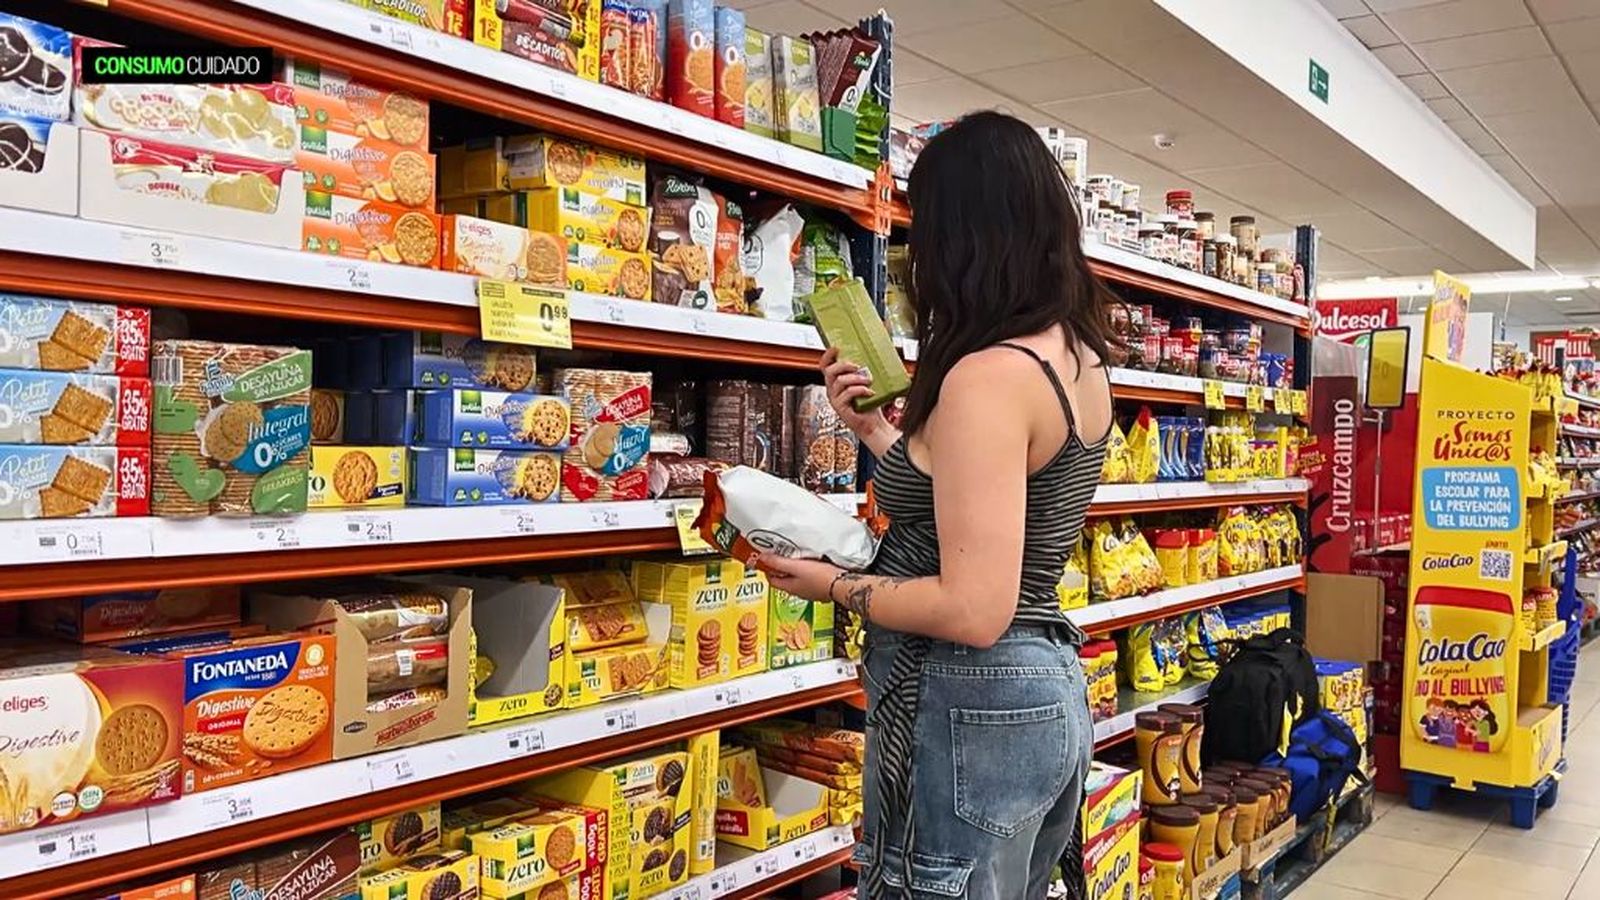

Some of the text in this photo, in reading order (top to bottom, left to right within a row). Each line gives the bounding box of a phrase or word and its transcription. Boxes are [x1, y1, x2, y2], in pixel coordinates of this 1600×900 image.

[335, 210, 391, 228] Digestive
[151, 242, 162, 257] 3
[347, 268, 357, 283] 2
[540, 302, 554, 333] 0
[240, 364, 303, 392] DESAYUNA
[121, 388, 148, 415] 35%
[253, 386, 270, 399] SIN
[120, 414, 148, 432] GRATIS
[1437, 410, 1515, 420] PROYECTO
[248, 409, 309, 443] Integral
[1453, 421, 1513, 446] Somos
[1433, 433, 1512, 462] Únic@s
[121, 457, 147, 484] 35%
[1325, 399, 1354, 532] Cruzcampo
[1444, 471, 1500, 484] PROGRAMA
[120, 482, 147, 500] GRATIS
[1435, 485, 1511, 498] ESCOLAR PARA
[1430, 499, 1512, 514] LA PREVENCIÓN
[366, 522, 376, 536] 2
[1436, 515, 1509, 529] DEL BULLYING
[276, 527, 286, 542] 2
[1422, 554, 1474, 571] ColaCao
[696, 586, 729, 605] zero
[735, 581, 765, 598] zero
[1418, 632, 1506, 667] ColaCao
[193, 651, 288, 684] FONTANEDA
[1432, 678, 1447, 697] AL
[3, 695, 46, 713] eliges
[196, 694, 257, 719] Digestive
[255, 701, 318, 725] Digestive
[499, 697, 528, 712] zero
[207, 718, 242, 731] ORIGINAL
[0, 729, 79, 759] Digestive
[228, 799, 238, 813] 3
[597, 811, 607, 863] GRATIS
[268, 854, 335, 900] DESAYUNA
[508, 857, 545, 883] zero
[640, 868, 664, 887] zero
